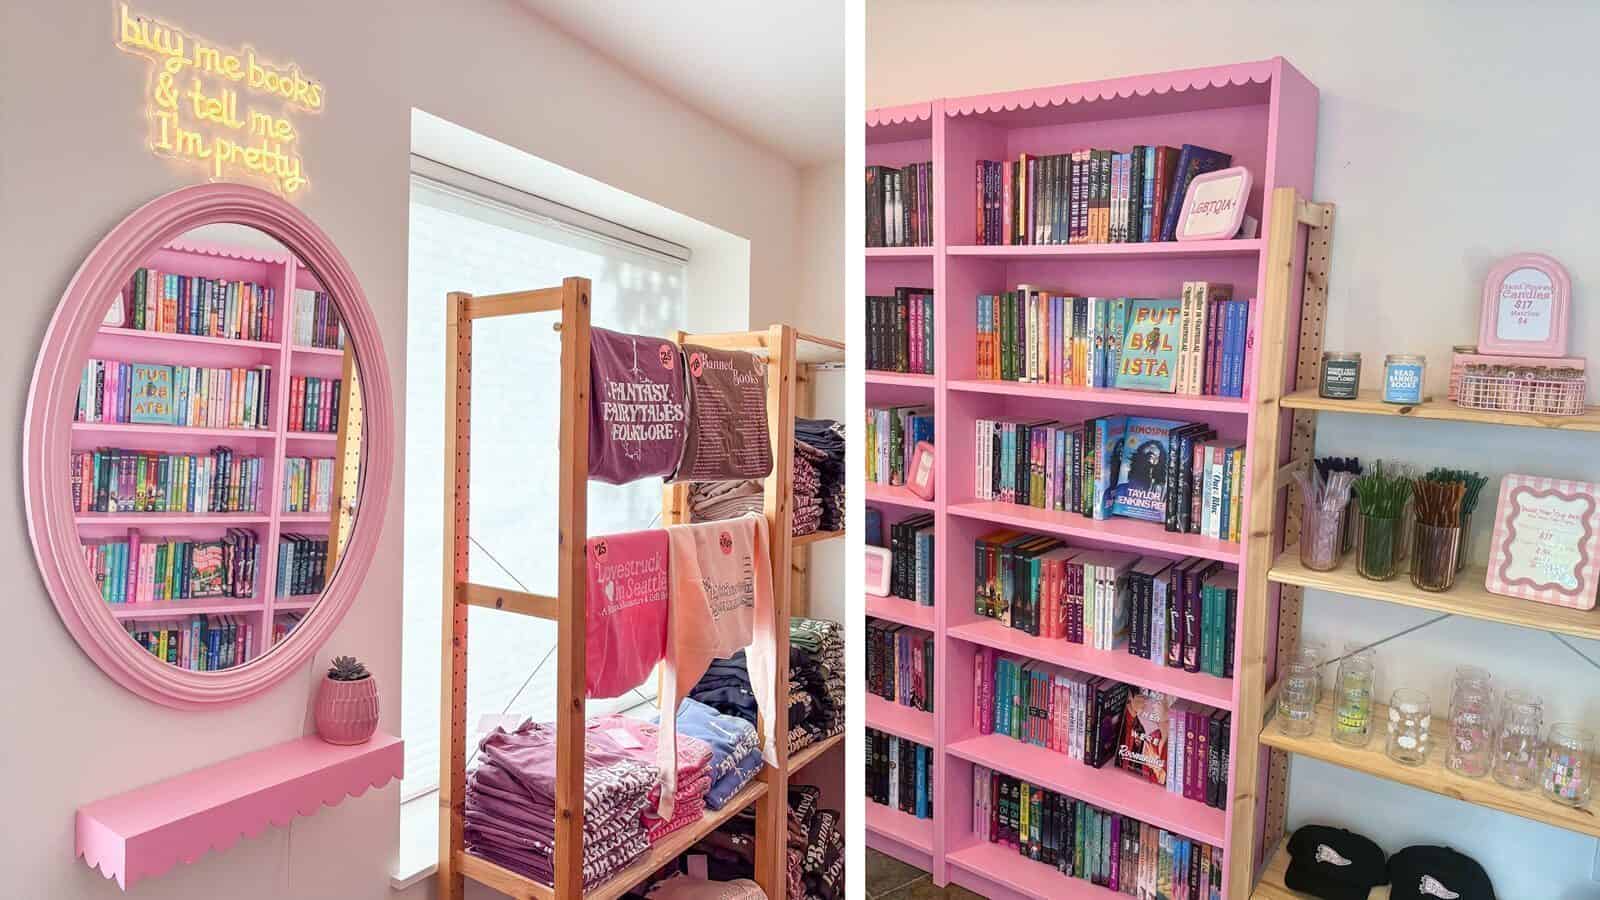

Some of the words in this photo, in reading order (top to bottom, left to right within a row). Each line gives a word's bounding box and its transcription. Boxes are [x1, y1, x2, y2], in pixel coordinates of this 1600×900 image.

[120, 3, 192, 73] buy
[193, 43, 245, 80] me
[247, 53, 322, 107] books
[155, 71, 179, 108] &
[187, 78, 246, 128] tell
[250, 111, 297, 141] me
[213, 137, 310, 193] pretty
[1191, 199, 1236, 216] LGBTQIA+
[1134, 306, 1180, 326] FUT
[702, 352, 733, 370] Banned
[1121, 358, 1170, 377] ISTA
[733, 369, 760, 385] Books
[609, 382, 669, 401] FANTASY
[601, 401, 684, 422] FAIRYTALES
[612, 424, 673, 440] FOLKLORE
[1128, 488, 1161, 500] TAYLOR
[596, 551, 662, 583] Lovestruck
[625, 568, 668, 600] Seattle
